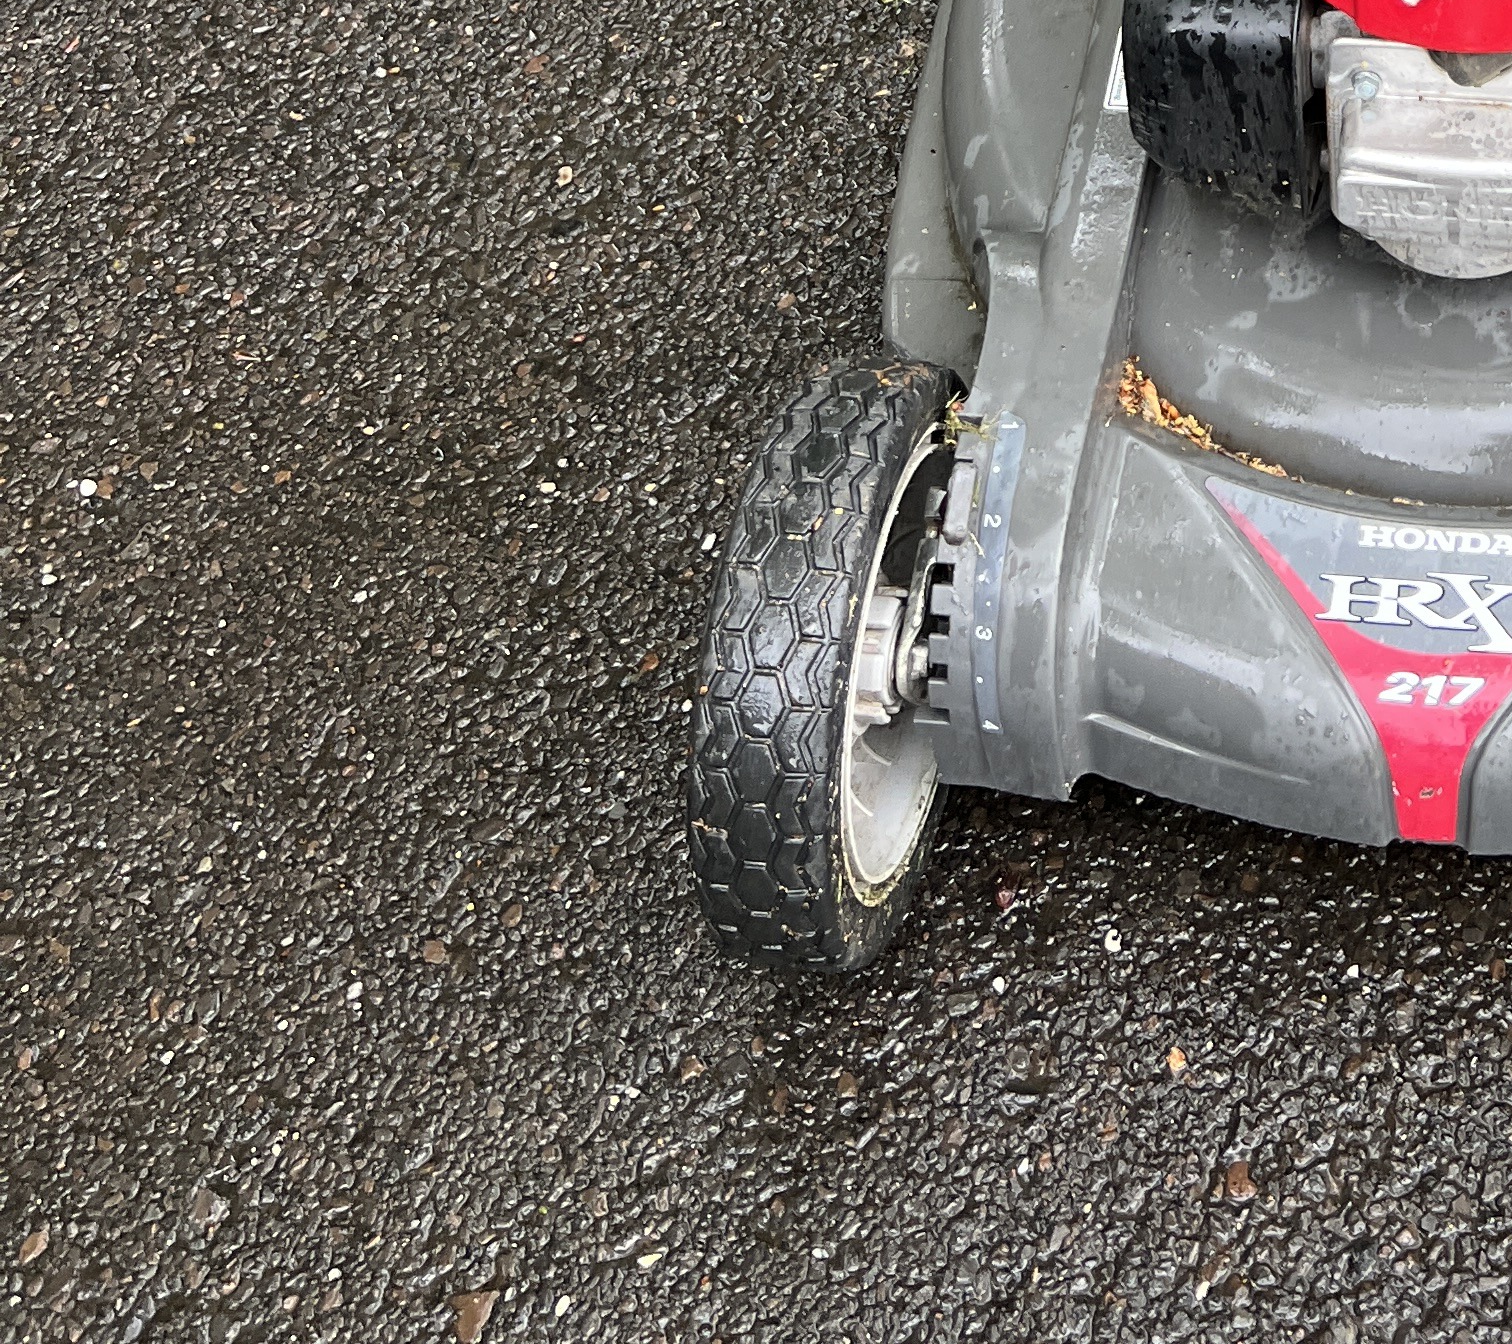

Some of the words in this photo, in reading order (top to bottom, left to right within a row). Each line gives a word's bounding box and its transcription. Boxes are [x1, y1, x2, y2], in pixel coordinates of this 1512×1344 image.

[1001, 420, 1020, 430] 1
[983, 513, 1002, 529] 2
[974, 625, 993, 641] 3
[1376, 670, 1488, 707] 217
